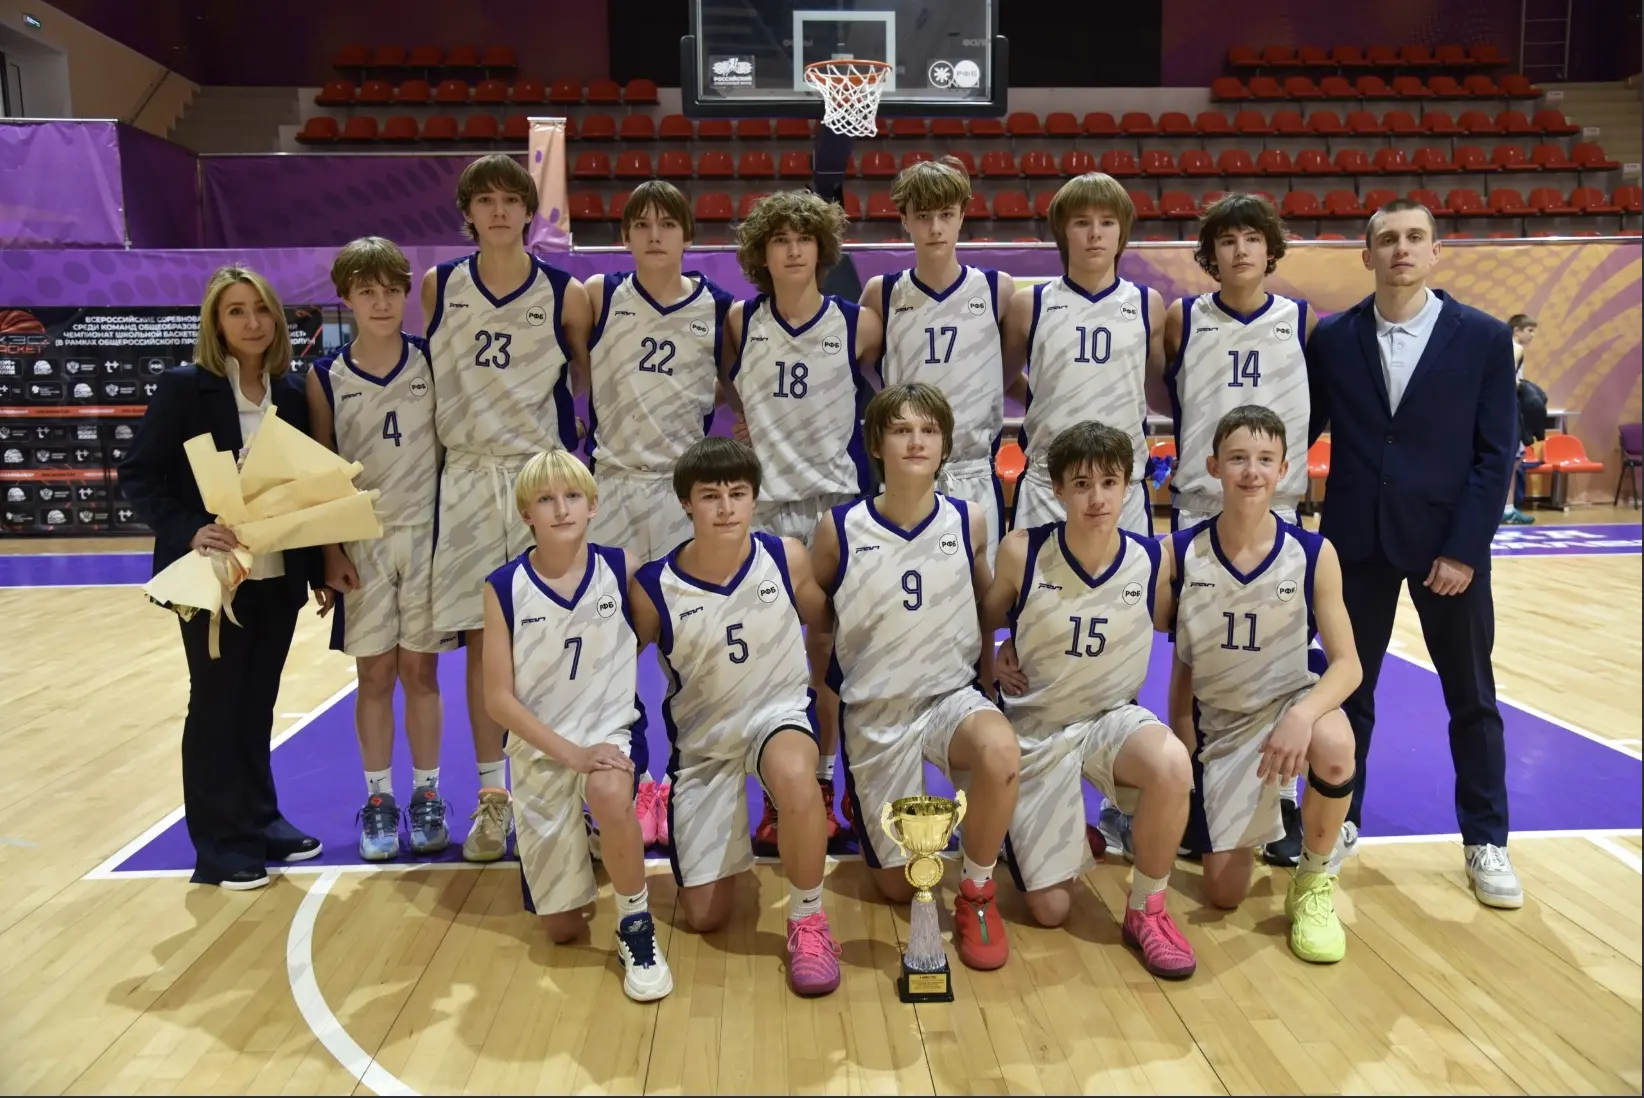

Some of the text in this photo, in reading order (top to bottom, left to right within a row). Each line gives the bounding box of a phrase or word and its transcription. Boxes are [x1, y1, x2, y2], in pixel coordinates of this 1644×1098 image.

[968, 302, 986, 312] РФБ
[1120, 306, 1138, 317] РФБ
[85, 315, 156, 323] ВСЕРОССИЙСКИЕ
[528, 311, 545, 321] РФБ
[72, 323, 100, 331] СРЕДИ
[101, 323, 137, 331] КОМАНД
[692, 323, 708, 333] РФБ
[1275, 327, 1291, 335] РФБ
[63, 331, 114, 339] ЧЕМПИОНАТ
[115, 330, 162, 338] ШКОЛЬНОЙ
[98, 337, 180, 346] ОБЩЕРОССИЙСКОГО
[823, 340, 840, 349] РФБ
[924, 326, 958, 365] 17
[1073, 326, 1112, 365] 10
[474, 329, 512, 370] 23
[638, 336, 677, 377] 22
[1227, 350, 1262, 388] 14
[411, 382, 427, 391] РФБ
[772, 361, 809, 400] 18
[382, 410, 403, 448] 4
[941, 540, 957, 548] РФБ
[760, 585, 777, 598] РФБ
[901, 569, 923, 612] 9
[1124, 589, 1142, 598] РФБ
[1064, 615, 1109, 658] 15
[1220, 611, 1262, 652] 11
[725, 622, 750, 665] 5
[563, 636, 584, 681] 7
